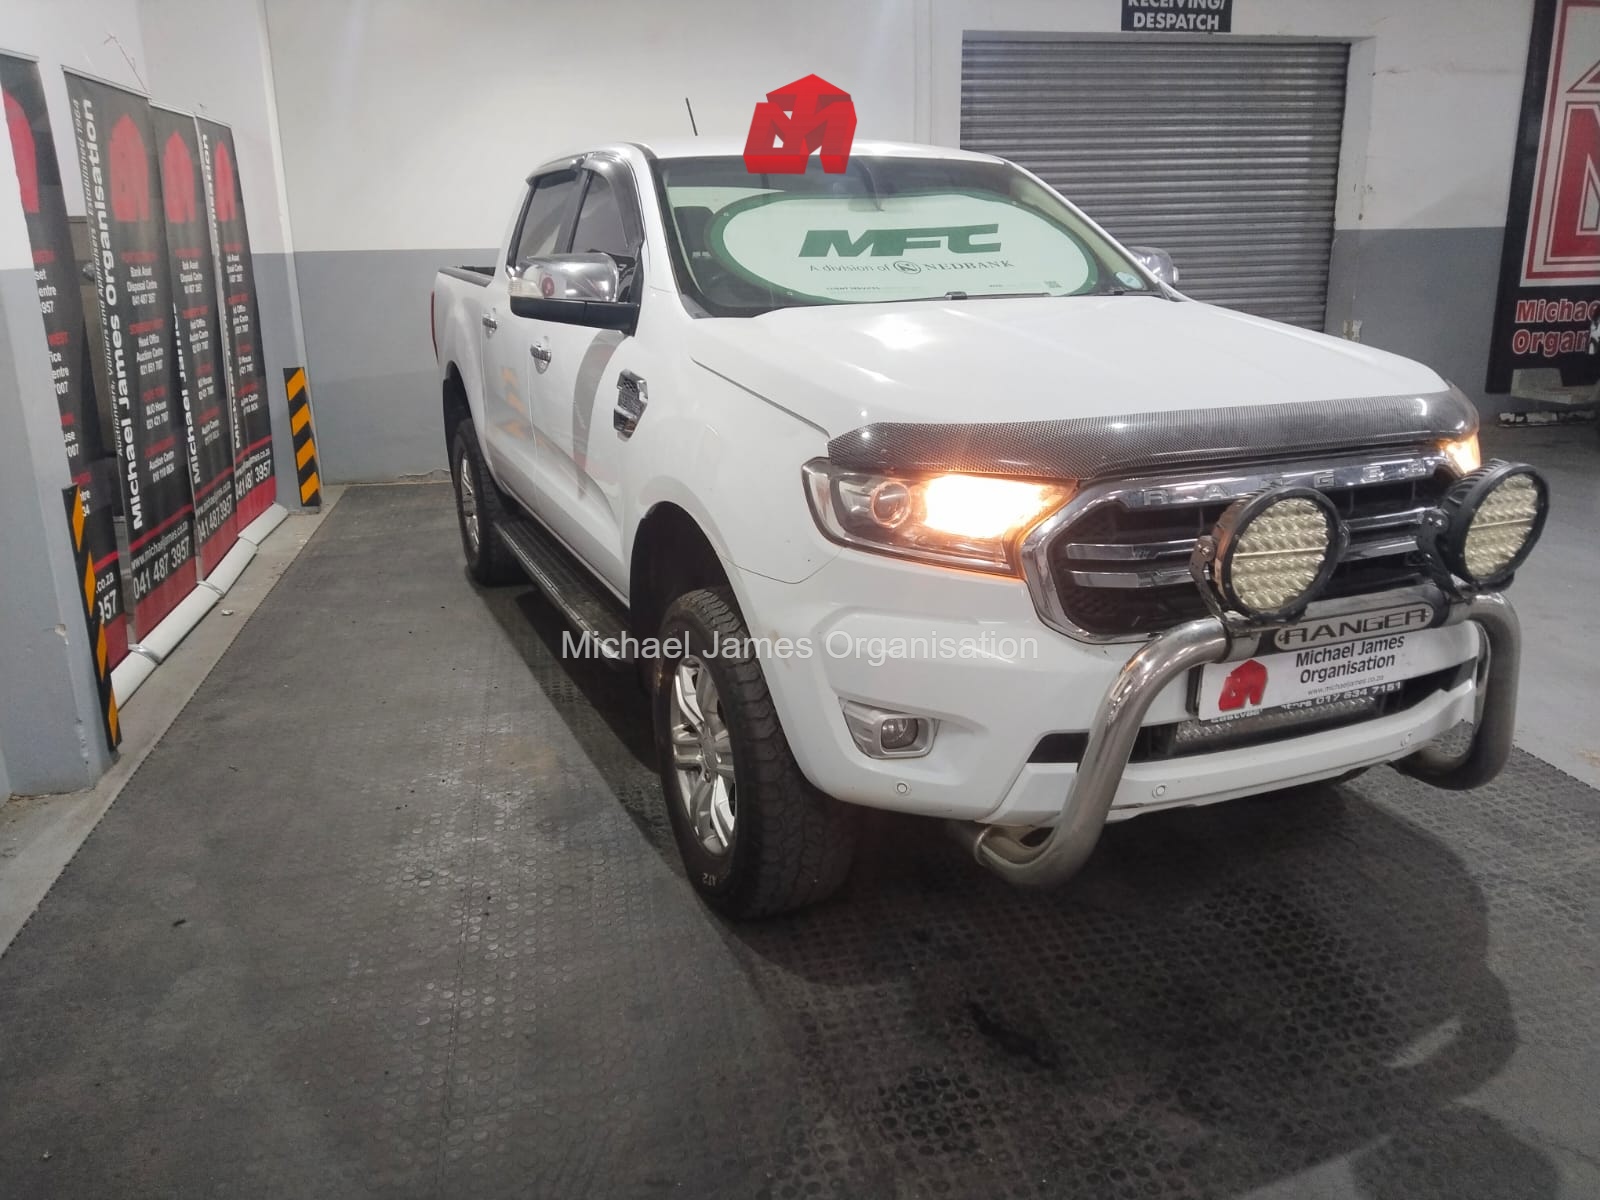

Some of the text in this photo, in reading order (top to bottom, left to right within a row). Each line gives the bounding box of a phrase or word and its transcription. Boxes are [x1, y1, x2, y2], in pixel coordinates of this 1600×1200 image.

[1133, 12, 1220, 30] DESPATCH
[798, 223, 1001, 258] MFC
[810, 259, 1015, 273] A division of NEDBANK
[83, 99, 143, 530] Michael James Organisation
[100, 299, 108, 326] and
[104, 329, 114, 376] Valuers
[181, 389, 201, 485] Michael
[254, 459, 271, 483] 3957
[133, 535, 190, 600] 041 487 3957
[1283, 607, 1427, 645] RANGER
[1296, 635, 1405, 668] Michael James
[1300, 654, 1395, 683] Organisation
